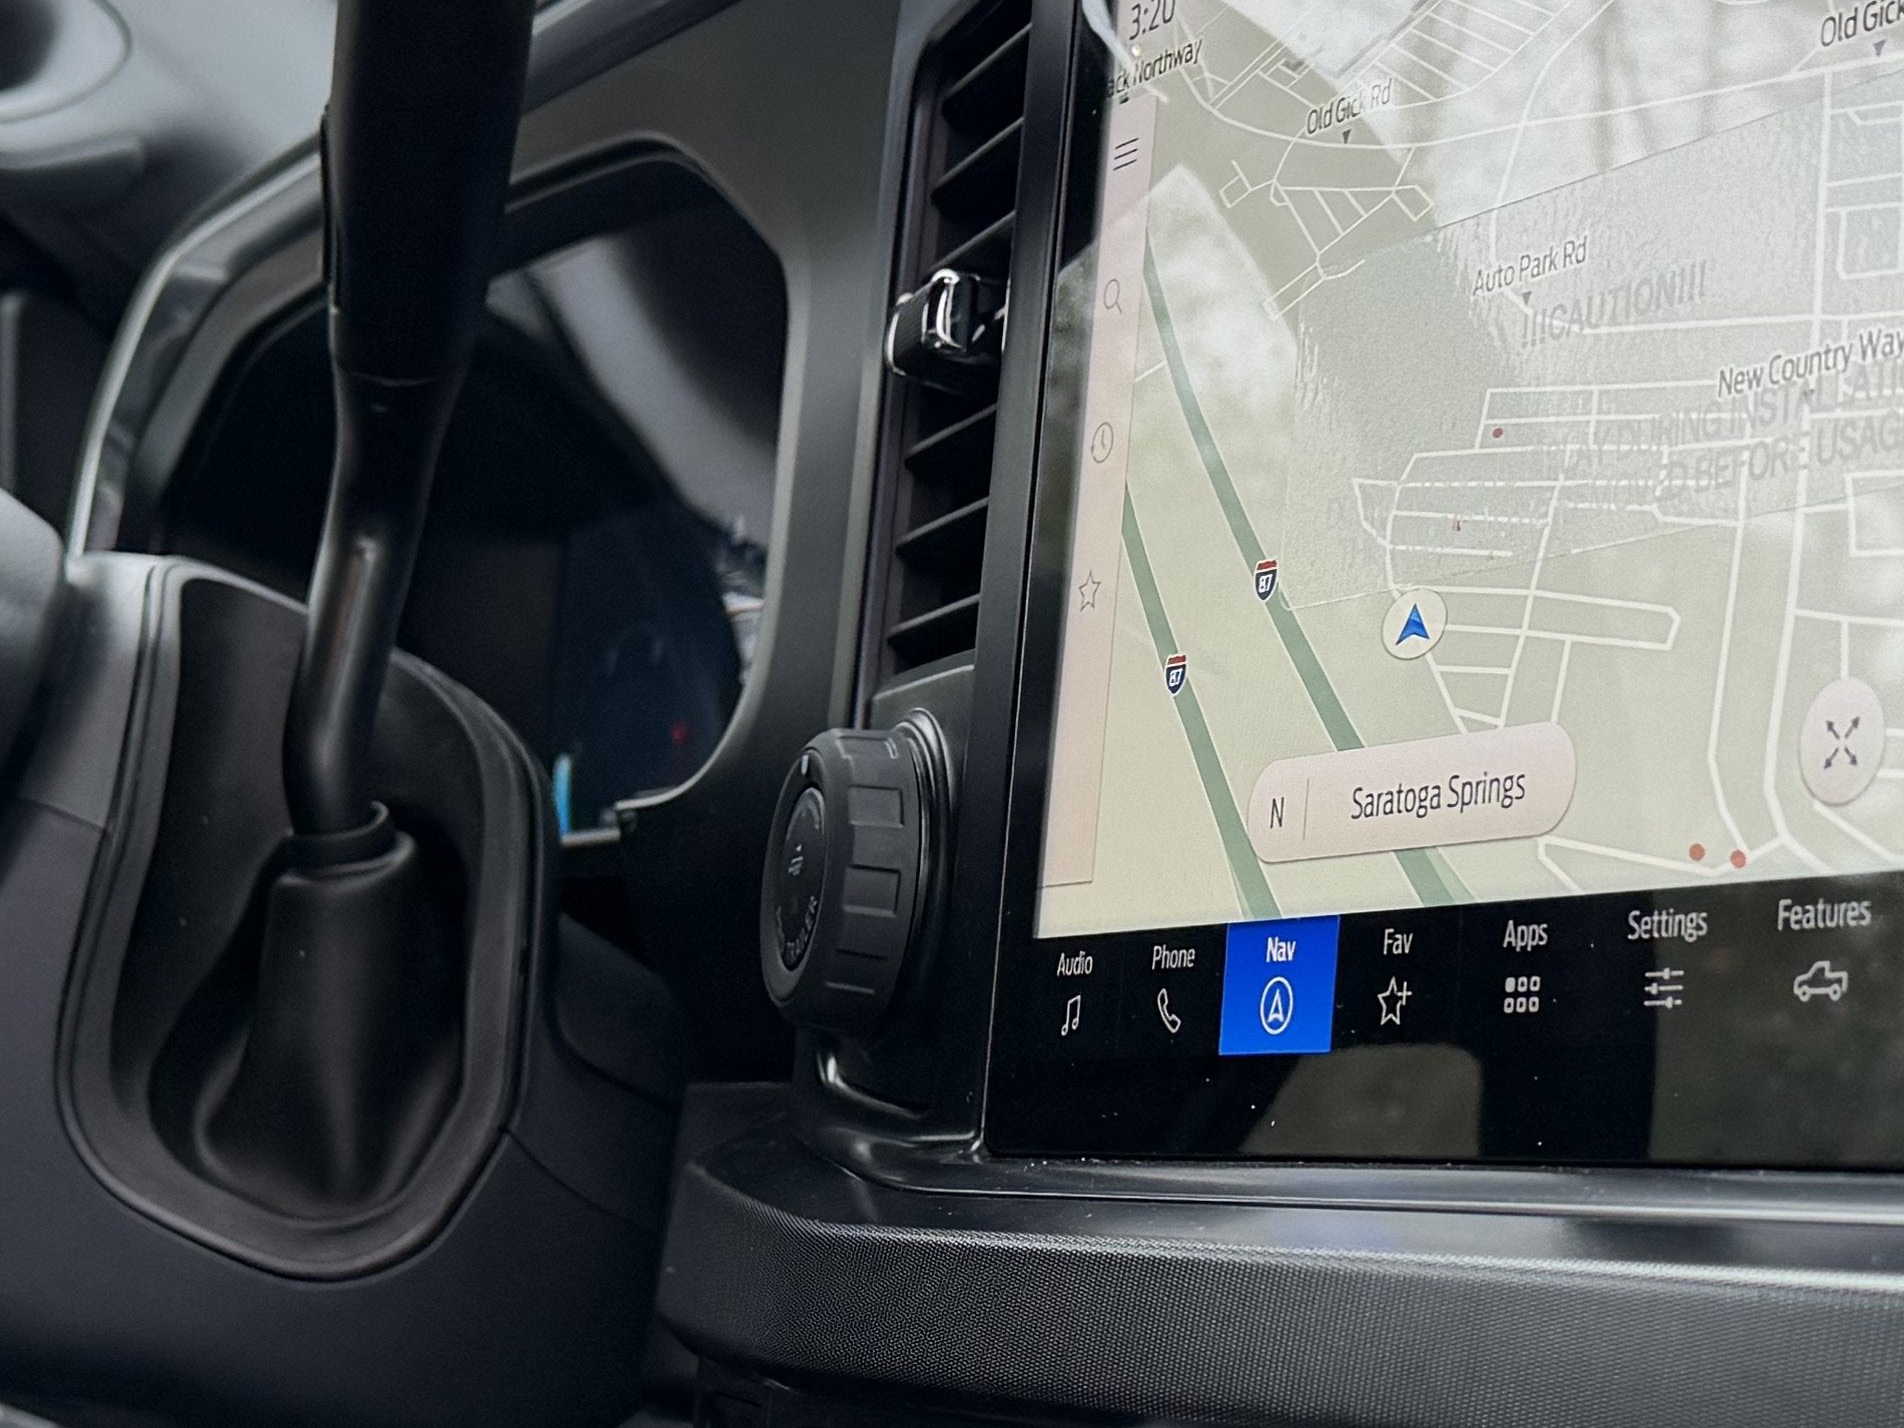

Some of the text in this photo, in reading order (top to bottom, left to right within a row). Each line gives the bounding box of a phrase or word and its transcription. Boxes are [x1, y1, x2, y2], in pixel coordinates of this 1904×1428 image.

[1820, 8, 1859, 47] Old
[1133, 39, 1203, 86] Northway
[1307, 78, 1393, 135] Old Gick Rd
[1473, 235, 1587, 296] Auto Park Rd
[1718, 365, 1764, 398] New
[1768, 342, 1853, 385] Country
[1270, 771, 1526, 828] N Saratoga Springs
[1627, 907, 1708, 942] Settings
[1777, 898, 1870, 931] Features
[1265, 938, 1295, 962] Nav
[1383, 929, 1413, 955] Fav
[1504, 919, 1548, 951] Apps
[1057, 951, 1093, 977] Audio
[1151, 944, 1195, 969] Phone
